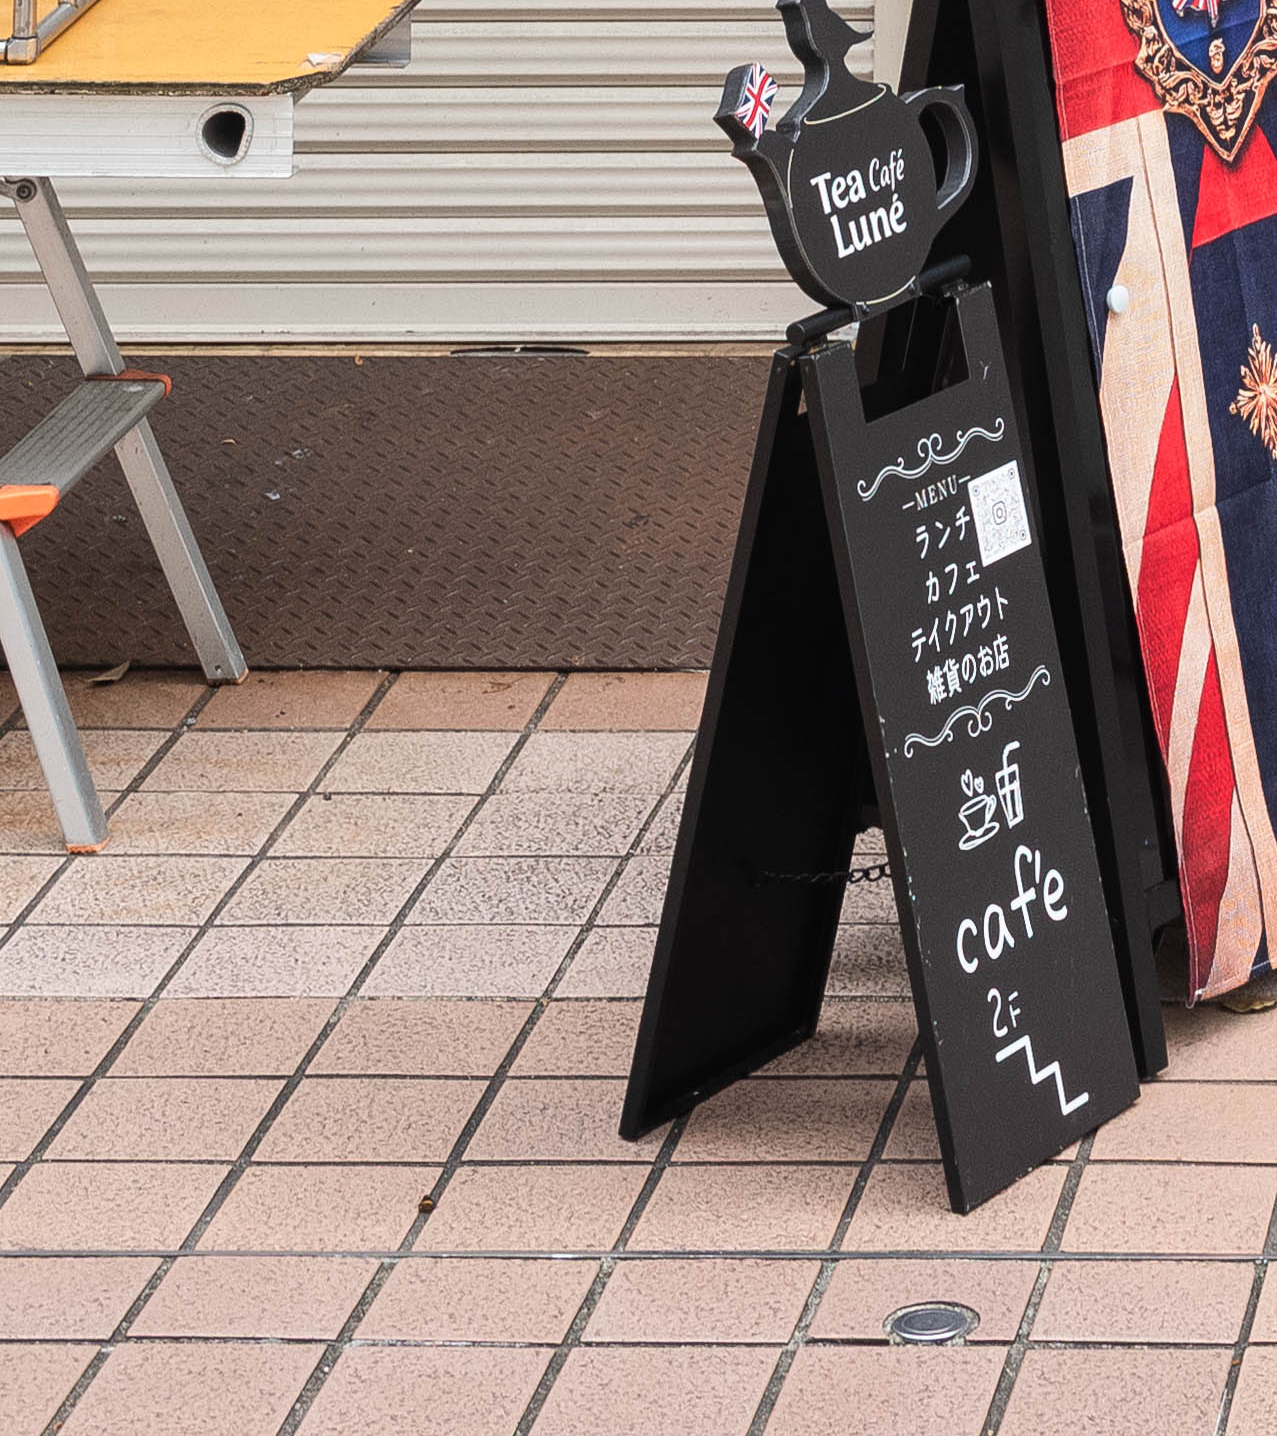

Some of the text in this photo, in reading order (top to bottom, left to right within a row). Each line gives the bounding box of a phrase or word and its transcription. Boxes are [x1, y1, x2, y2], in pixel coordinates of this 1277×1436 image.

[810, 148, 905, 215] Tea Café
[829, 192, 907, 259] Luné
[915, 505, 970, 559] ランチ
[925, 560, 981, 604] カフェ
[911, 586, 1009, 663] テイクアウト
[925, 633, 1010, 705] 雑貨のお店
[987, 987, 1021, 1038] 2F
